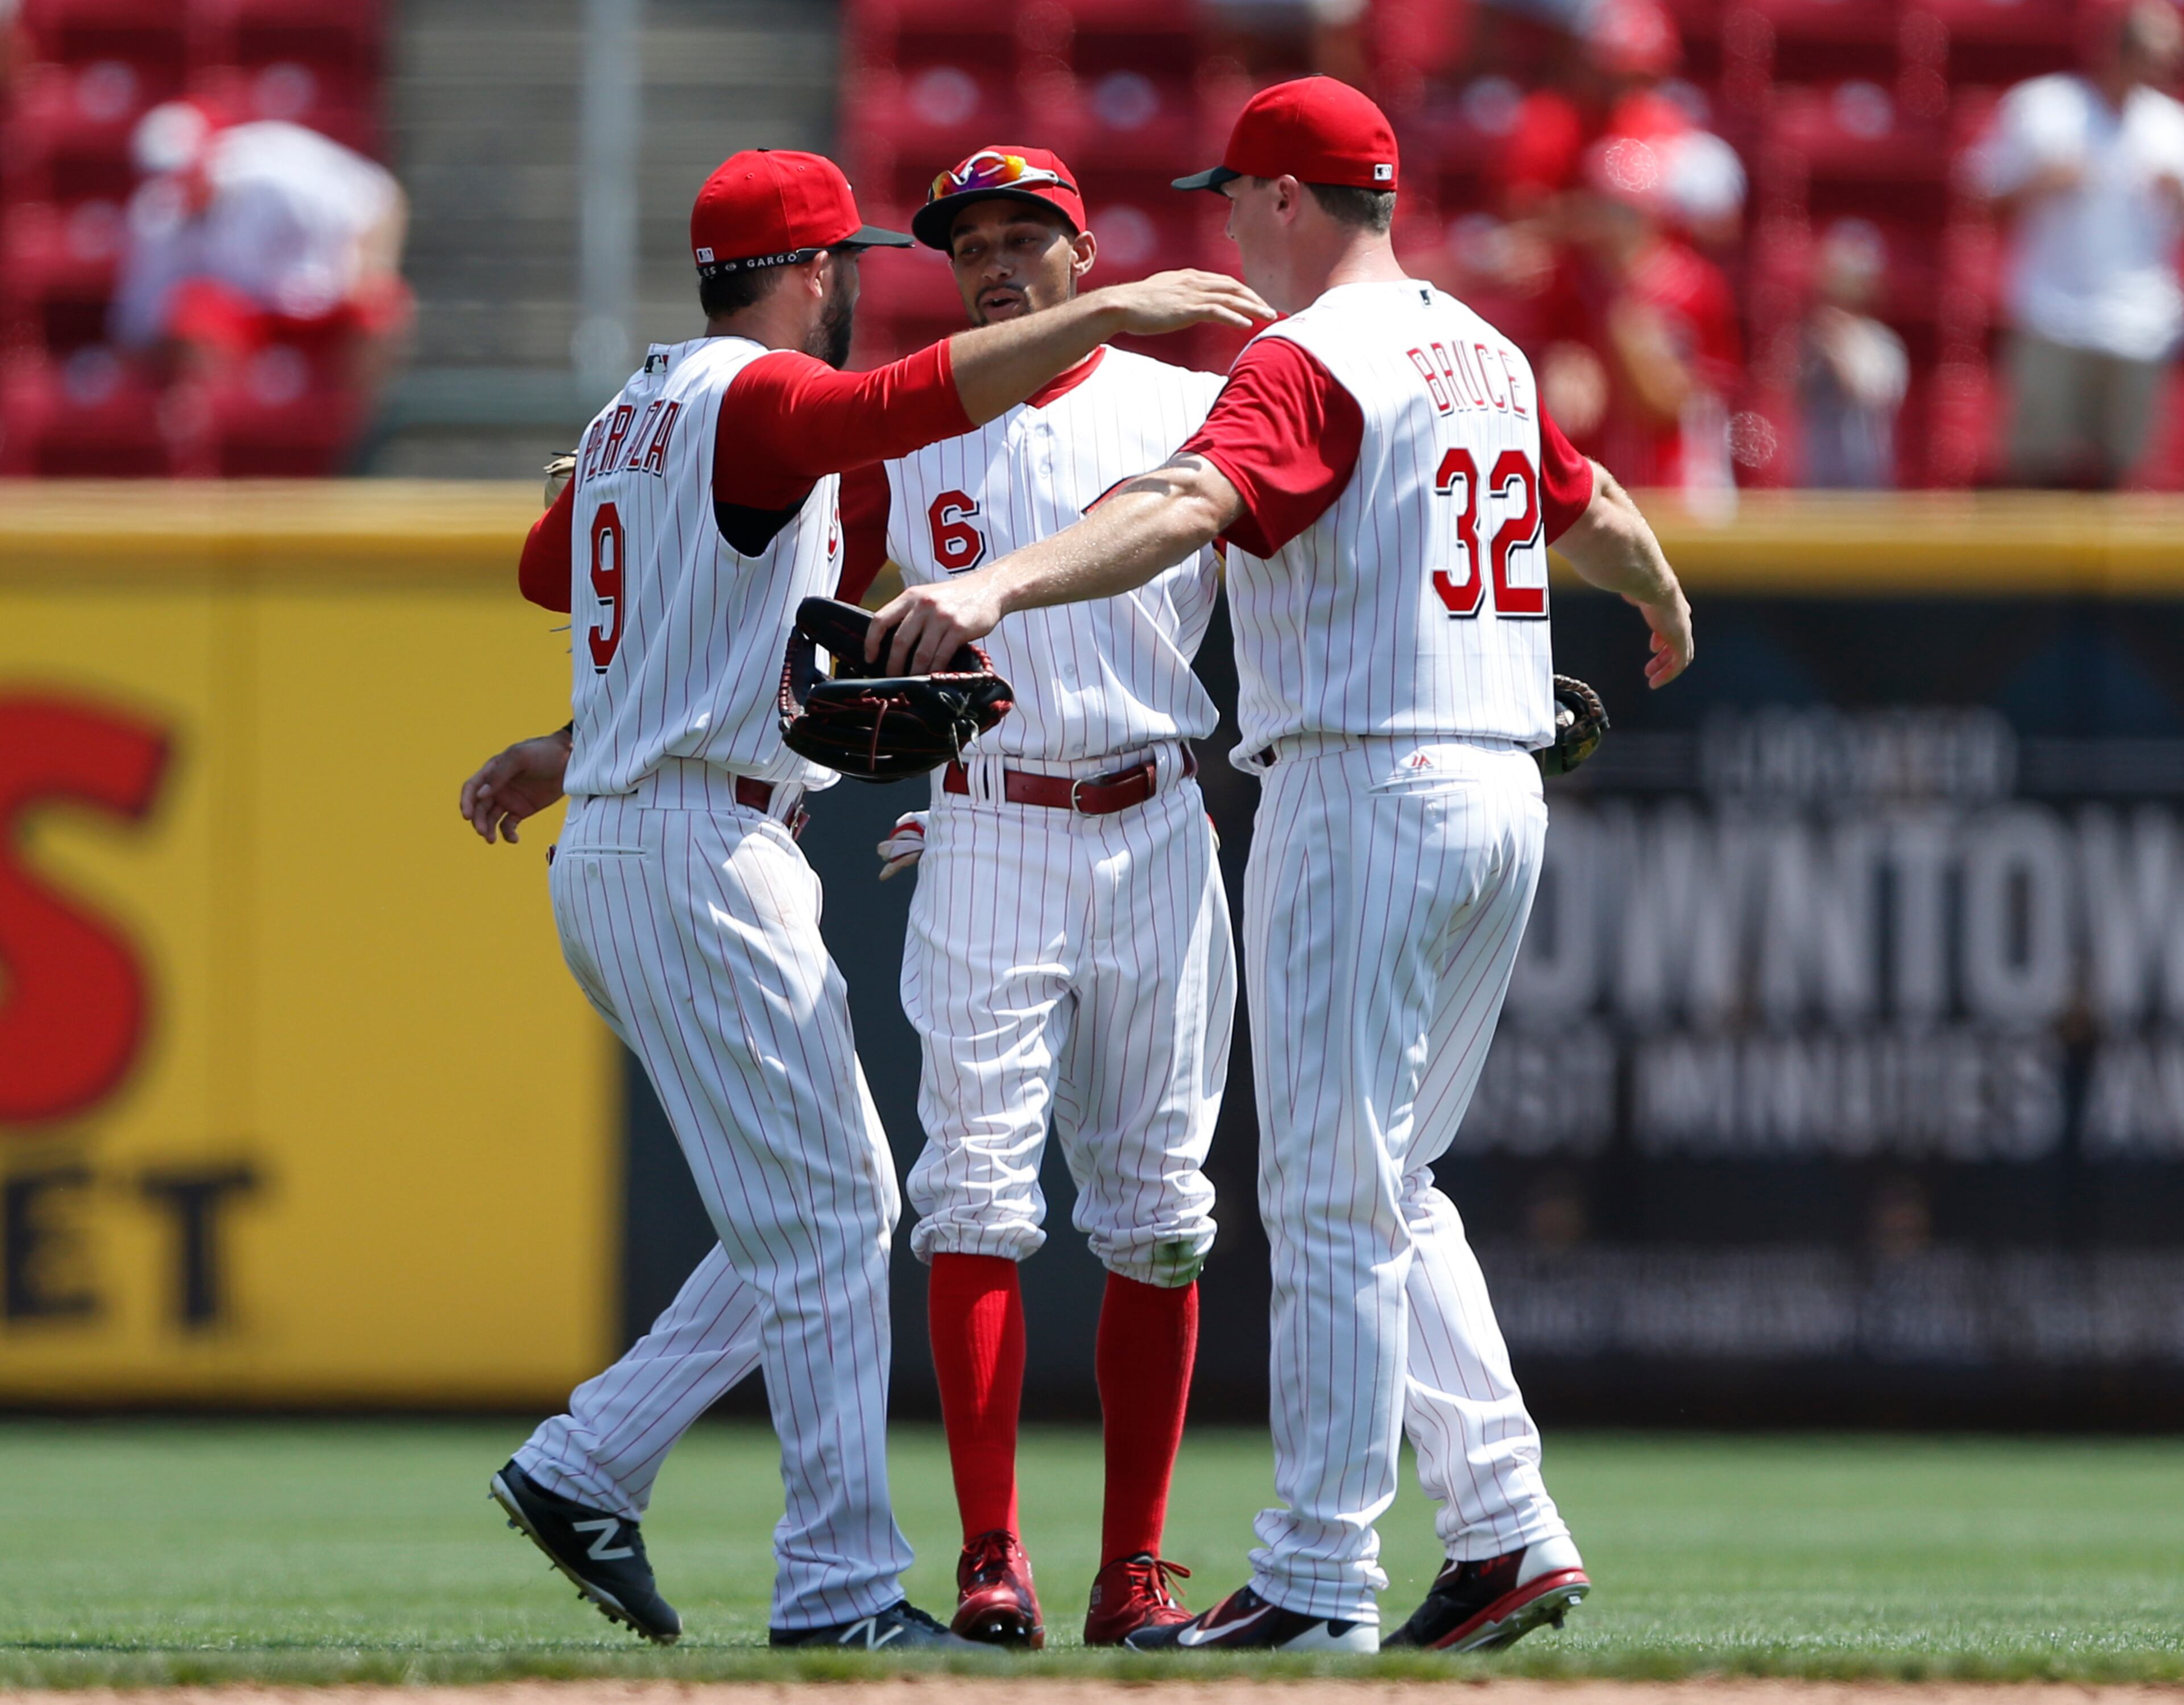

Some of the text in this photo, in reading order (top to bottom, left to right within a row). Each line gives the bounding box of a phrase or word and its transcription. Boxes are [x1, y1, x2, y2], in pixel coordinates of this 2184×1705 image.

[746, 253, 797, 268] GARGO
[1406, 341, 1529, 420] BRUCE
[588, 501, 625, 674] 9
[928, 489, 986, 573] 6
[1432, 447, 1549, 620] 32
[0, 1163, 267, 1328] ET
